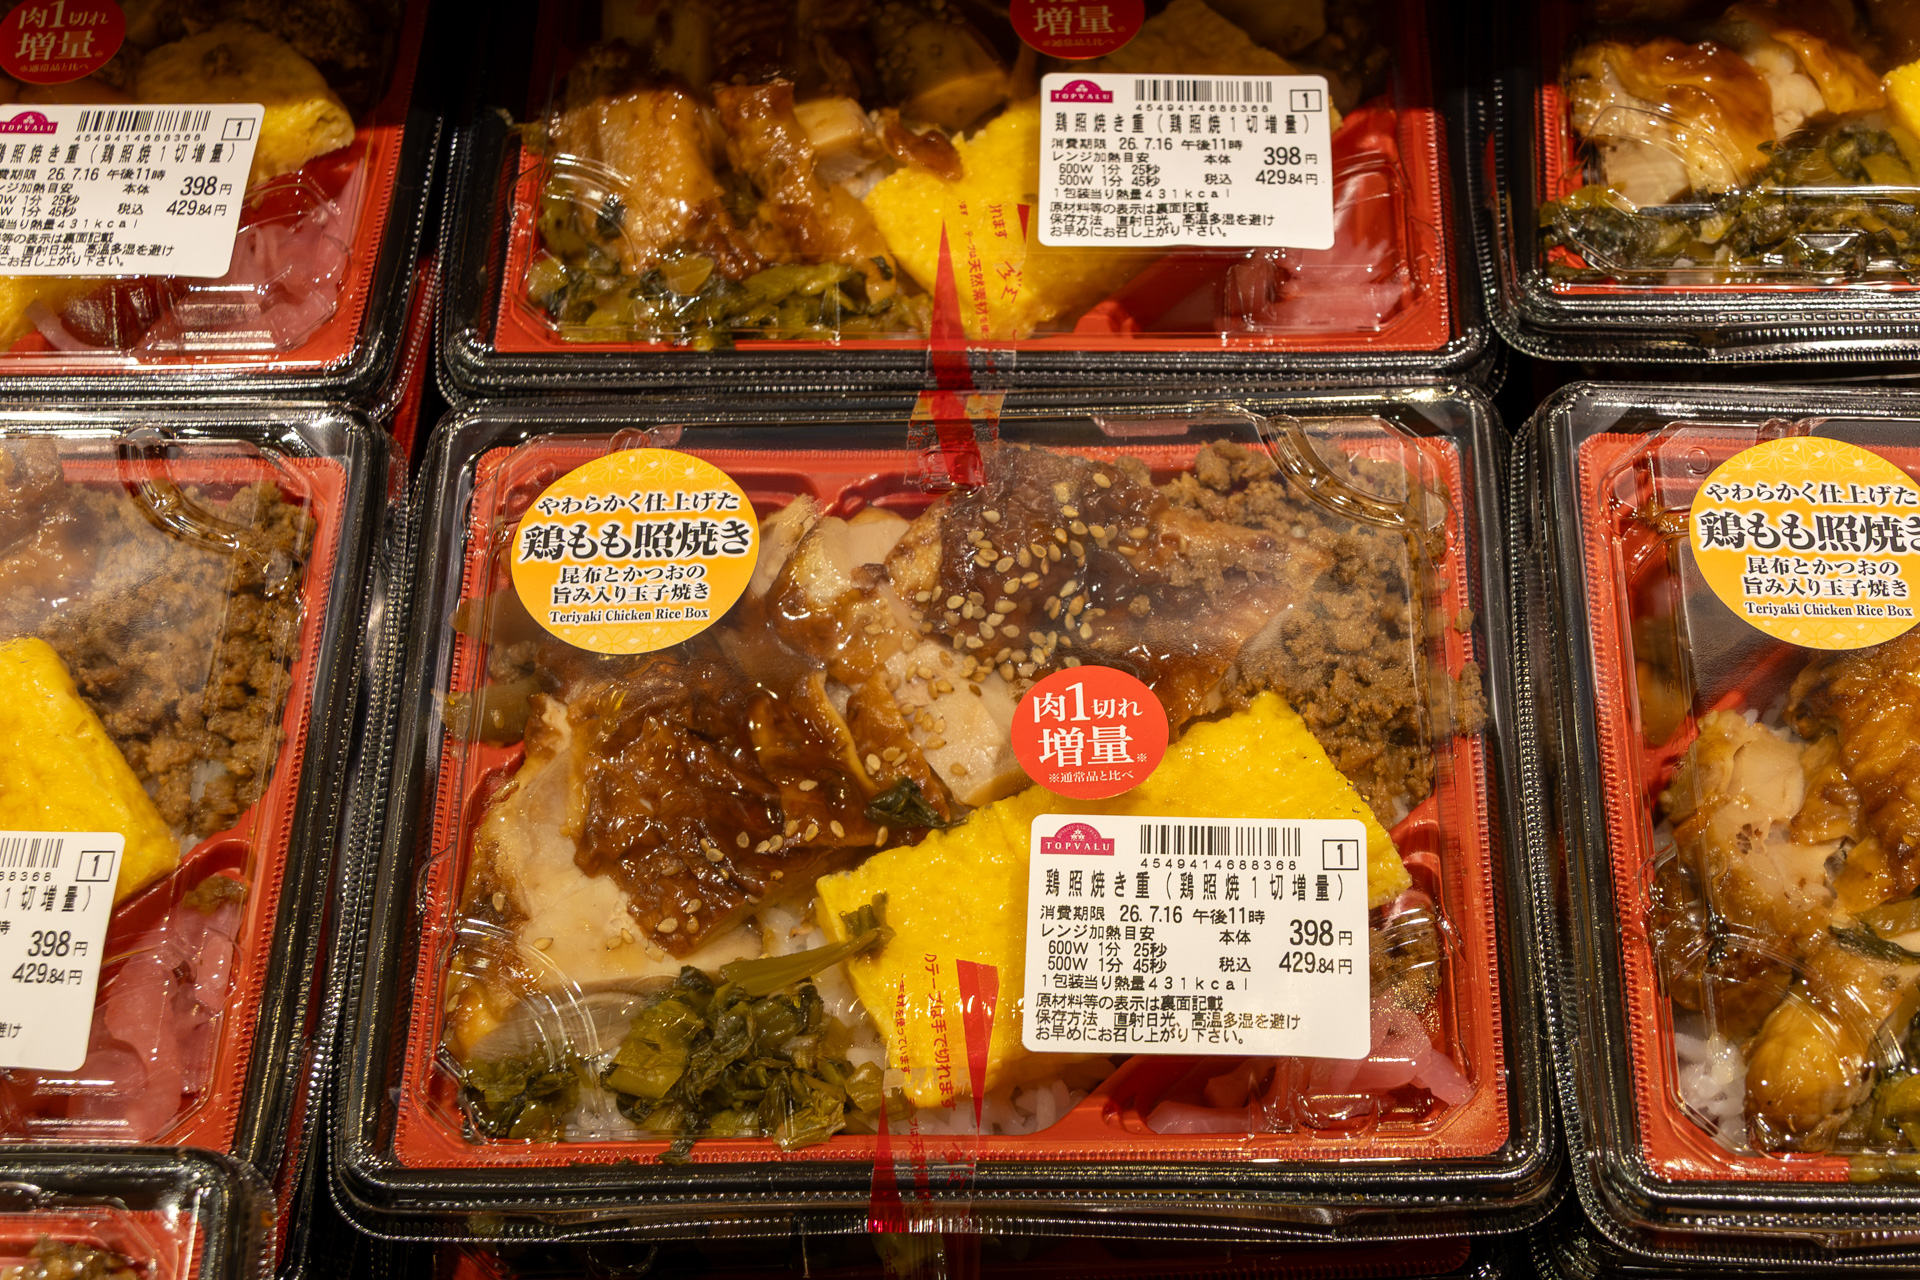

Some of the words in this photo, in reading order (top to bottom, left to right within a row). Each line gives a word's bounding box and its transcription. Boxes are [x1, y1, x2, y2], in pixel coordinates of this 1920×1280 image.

[18, 0, 109, 30] 肉1切れ
[1136, 104, 1269, 113] 4549414688368
[1302, 93, 1309, 108] 1
[236, 122, 242, 137] 1
[1051, 138, 1106, 150] 消費期限
[1181, 139, 1243, 151] 午後11時
[1052, 152, 1149, 163] レンジ加熱目安
[1204, 154, 1231, 165] 本体
[107, 168, 166, 181] 午後11時
[1059, 164, 1093, 173] 600W
[1059, 175, 1093, 185] 500W
[1204, 173, 1232, 185] 税込
[123, 184, 149, 194] 本体
[118, 204, 143, 214] 税込
[1050, 215, 1102, 226] 保存方法
[1707, 483, 1917, 505] やわらかく仕上げた
[539, 492, 739, 515] やわらかく仕上げた
[521, 521, 750, 561] 鶏もも照焼き
[1748, 557, 1899, 576] 昆布とかつおの
[560, 566, 705, 584] 昆布とかつおの
[554, 583, 708, 604] 旨み入り玉子焼き
[1744, 577, 1907, 597] 旨み入り玉子焼き
[550, 611, 601, 623] Teriyaki
[605, 609, 651, 621] Chicken
[656, 608, 681, 619] Rice
[685, 608, 708, 618] Box
[1745, 602, 1799, 615] Teriyaki
[1804, 604, 1852, 615] Chicken
[1856, 605, 1883, 616] Rice
[1888, 605, 1912, 616] Box
[1033, 682, 1143, 723] 肉1切れ
[1046, 842, 1110, 850] TOPVALU
[1336, 844, 1345, 866] 1
[93, 855, 100, 877] 1
[1141, 859, 1297, 870] 4549414688368
[1040, 905, 1105, 921] 消費期限
[1193, 908, 1265, 925] 午後11時
[1041, 923, 1155, 941] レンジ加熱目安
[1219, 930, 1251, 944] 本体
[1048, 941, 1088, 955] 600W
[1133, 943, 1167, 957] 25秒
[1048, 956, 1088, 970] 500W
[1133, 958, 1167, 973] 45秒
[1219, 957, 1251, 973] 税込
[1036, 994, 1223, 1011] 原材料等の表示は裏面記載
[1036, 1010, 1097, 1026] 保存方法
[1114, 1013, 1301, 1030] 直射日光、高温多湿を避け
[1035, 1026, 1245, 1044] お早めにお召し上がり下さい。
